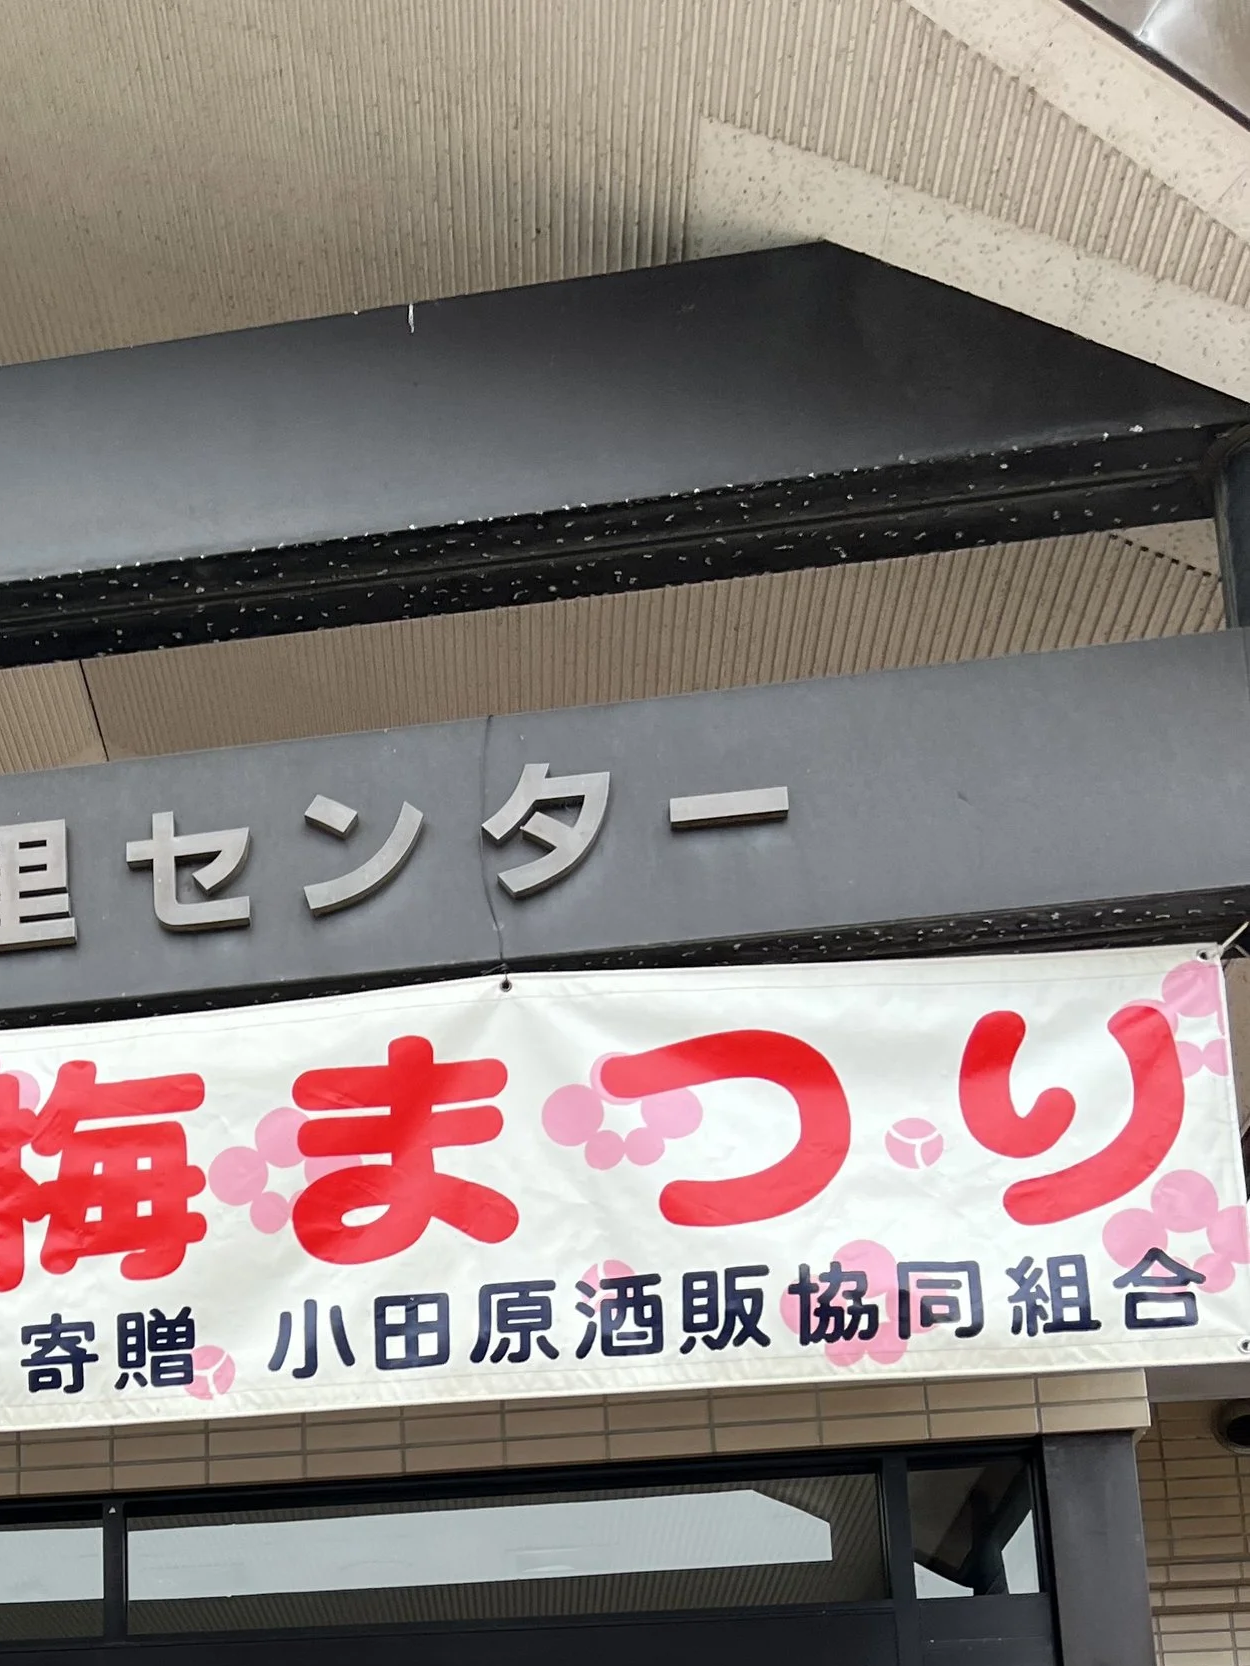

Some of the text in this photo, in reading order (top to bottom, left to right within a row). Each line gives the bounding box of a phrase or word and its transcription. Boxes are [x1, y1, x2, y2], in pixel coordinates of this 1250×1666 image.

[20, 1246, 1206, 1394] 寄贈 小田原酒販協同組合
